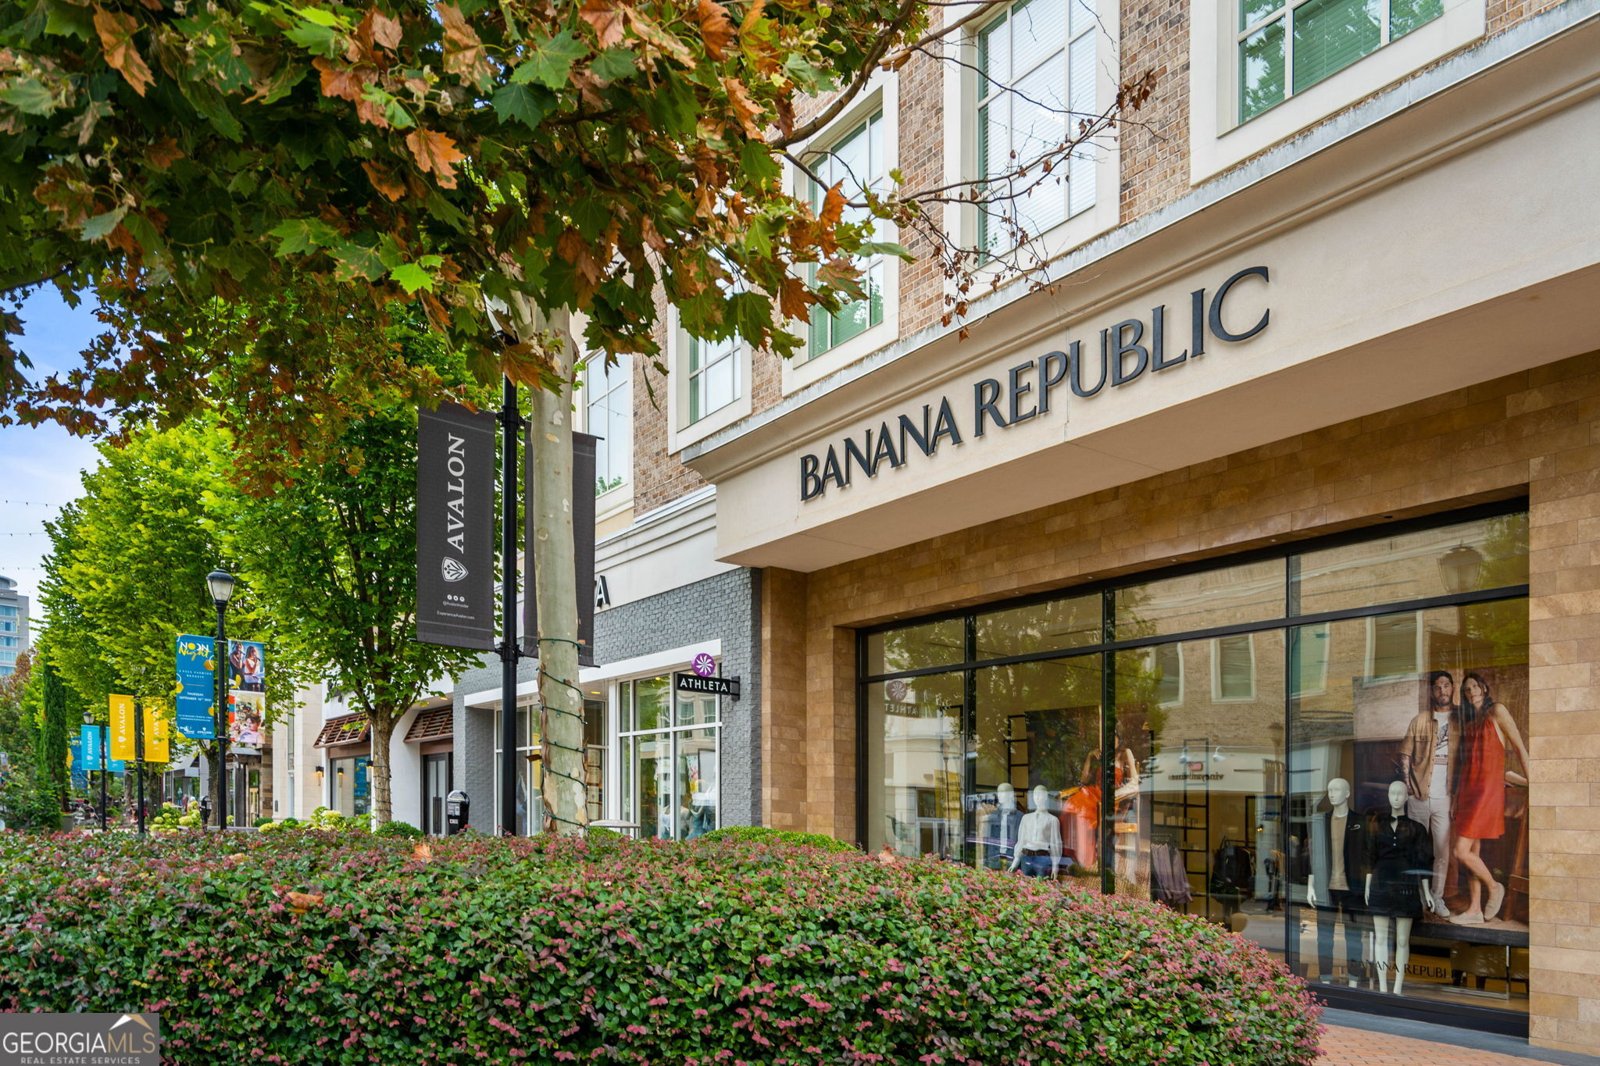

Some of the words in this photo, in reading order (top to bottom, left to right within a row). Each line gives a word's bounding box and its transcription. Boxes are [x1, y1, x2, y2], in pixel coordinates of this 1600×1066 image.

[800, 396, 964, 501] BANANA
[973, 265, 1270, 438] REPUBLIC
[447, 432, 465, 553] AVALON
[680, 677, 728, 692] ATHLETA
